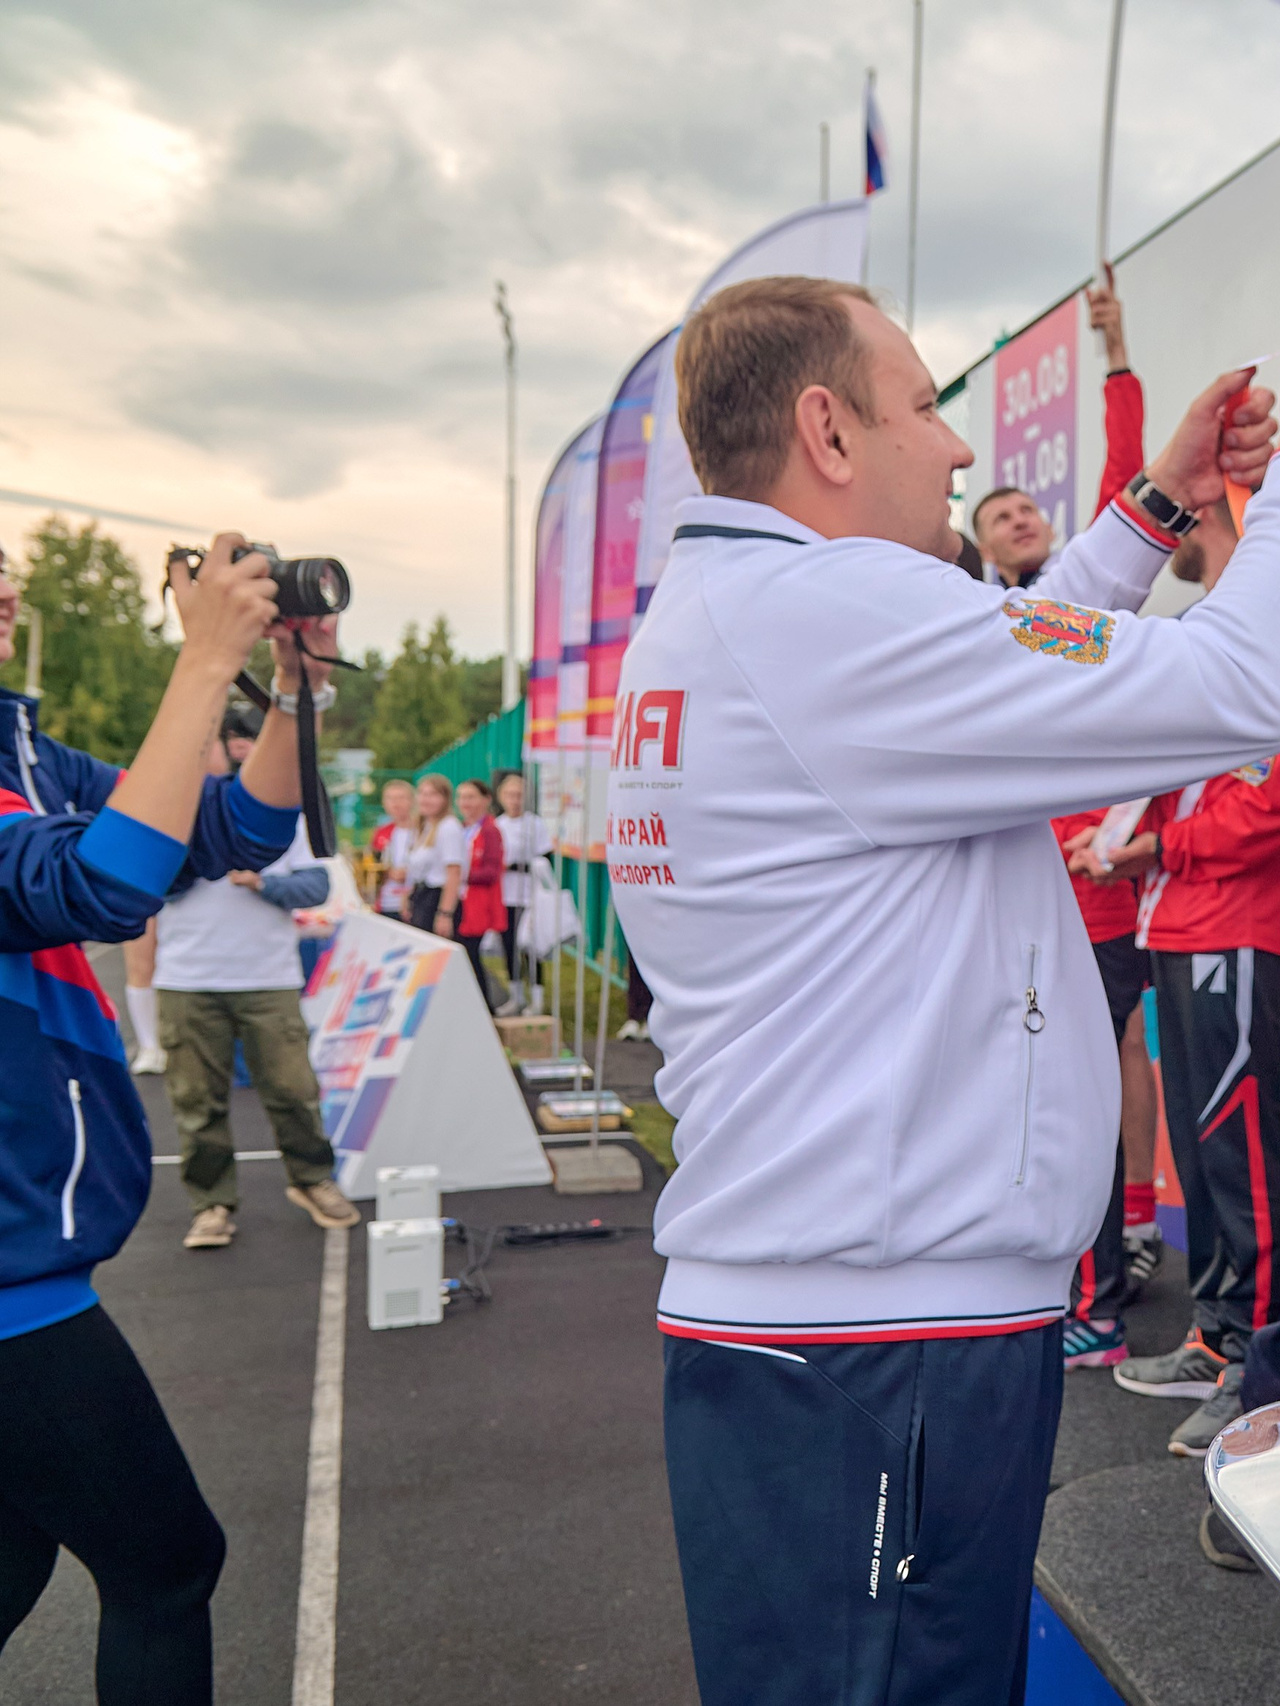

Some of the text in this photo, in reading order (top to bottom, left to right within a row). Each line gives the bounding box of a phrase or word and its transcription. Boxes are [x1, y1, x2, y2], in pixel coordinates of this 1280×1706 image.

[618, 811, 668, 847] КРАЙ
[868, 1472, 888, 1600] МЫ ВМЕСТЕ СПОРТ
